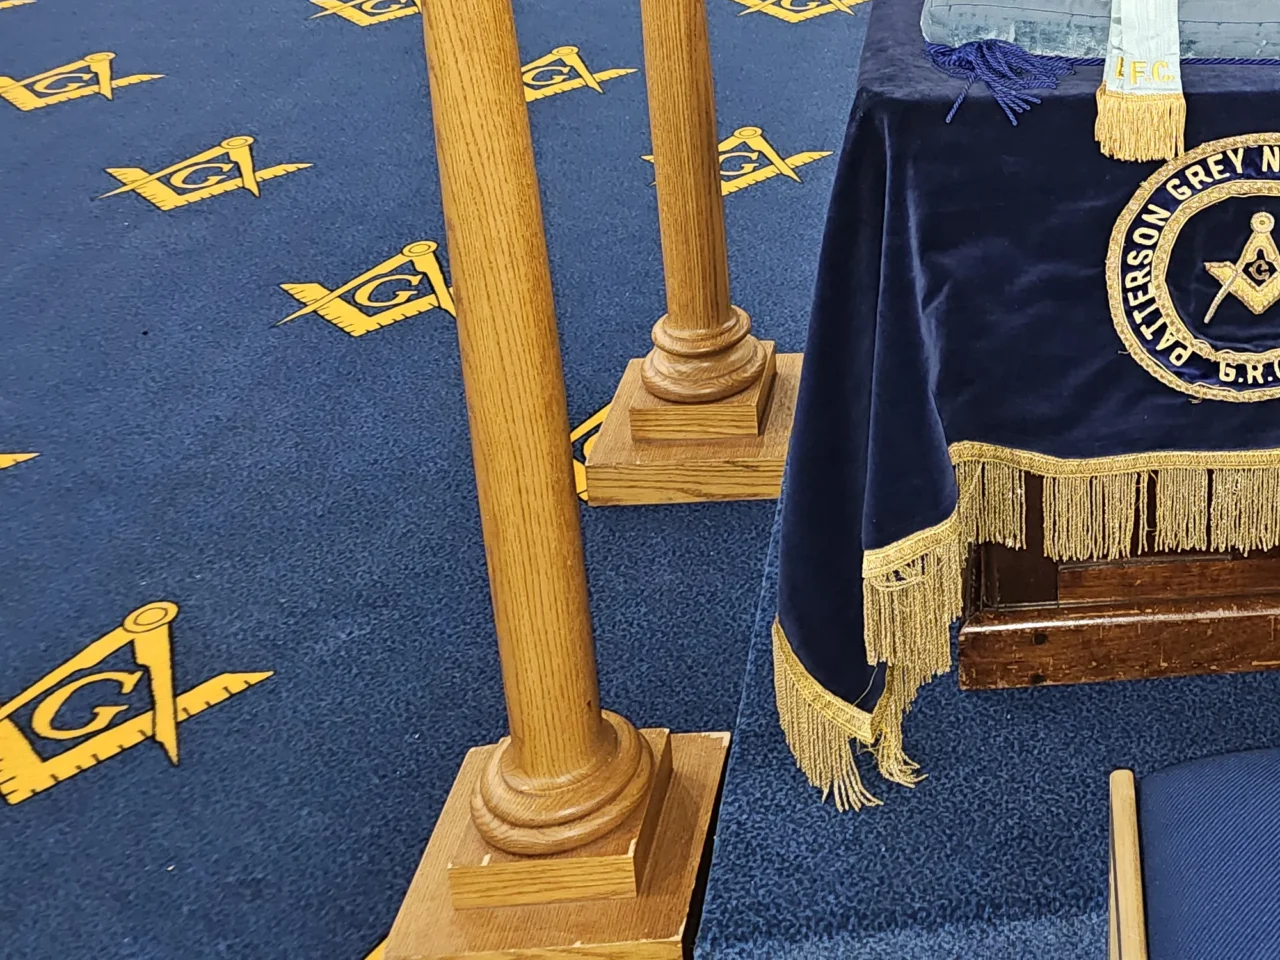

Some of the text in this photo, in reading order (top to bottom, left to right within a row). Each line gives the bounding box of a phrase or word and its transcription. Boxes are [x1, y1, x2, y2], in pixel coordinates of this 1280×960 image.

[33, 73, 94, 93] G
[522, 66, 571, 85] G
[1130, 61, 1175, 85] F.C.
[170, 163, 234, 189] G
[719, 152, 760, 176] G
[1125, 204, 1193, 366] PATTERSON
[1166, 148, 1244, 201] GREY
[1248, 259, 1270, 280] G
[354, 274, 423, 307] G
[32, 672, 142, 739] G
